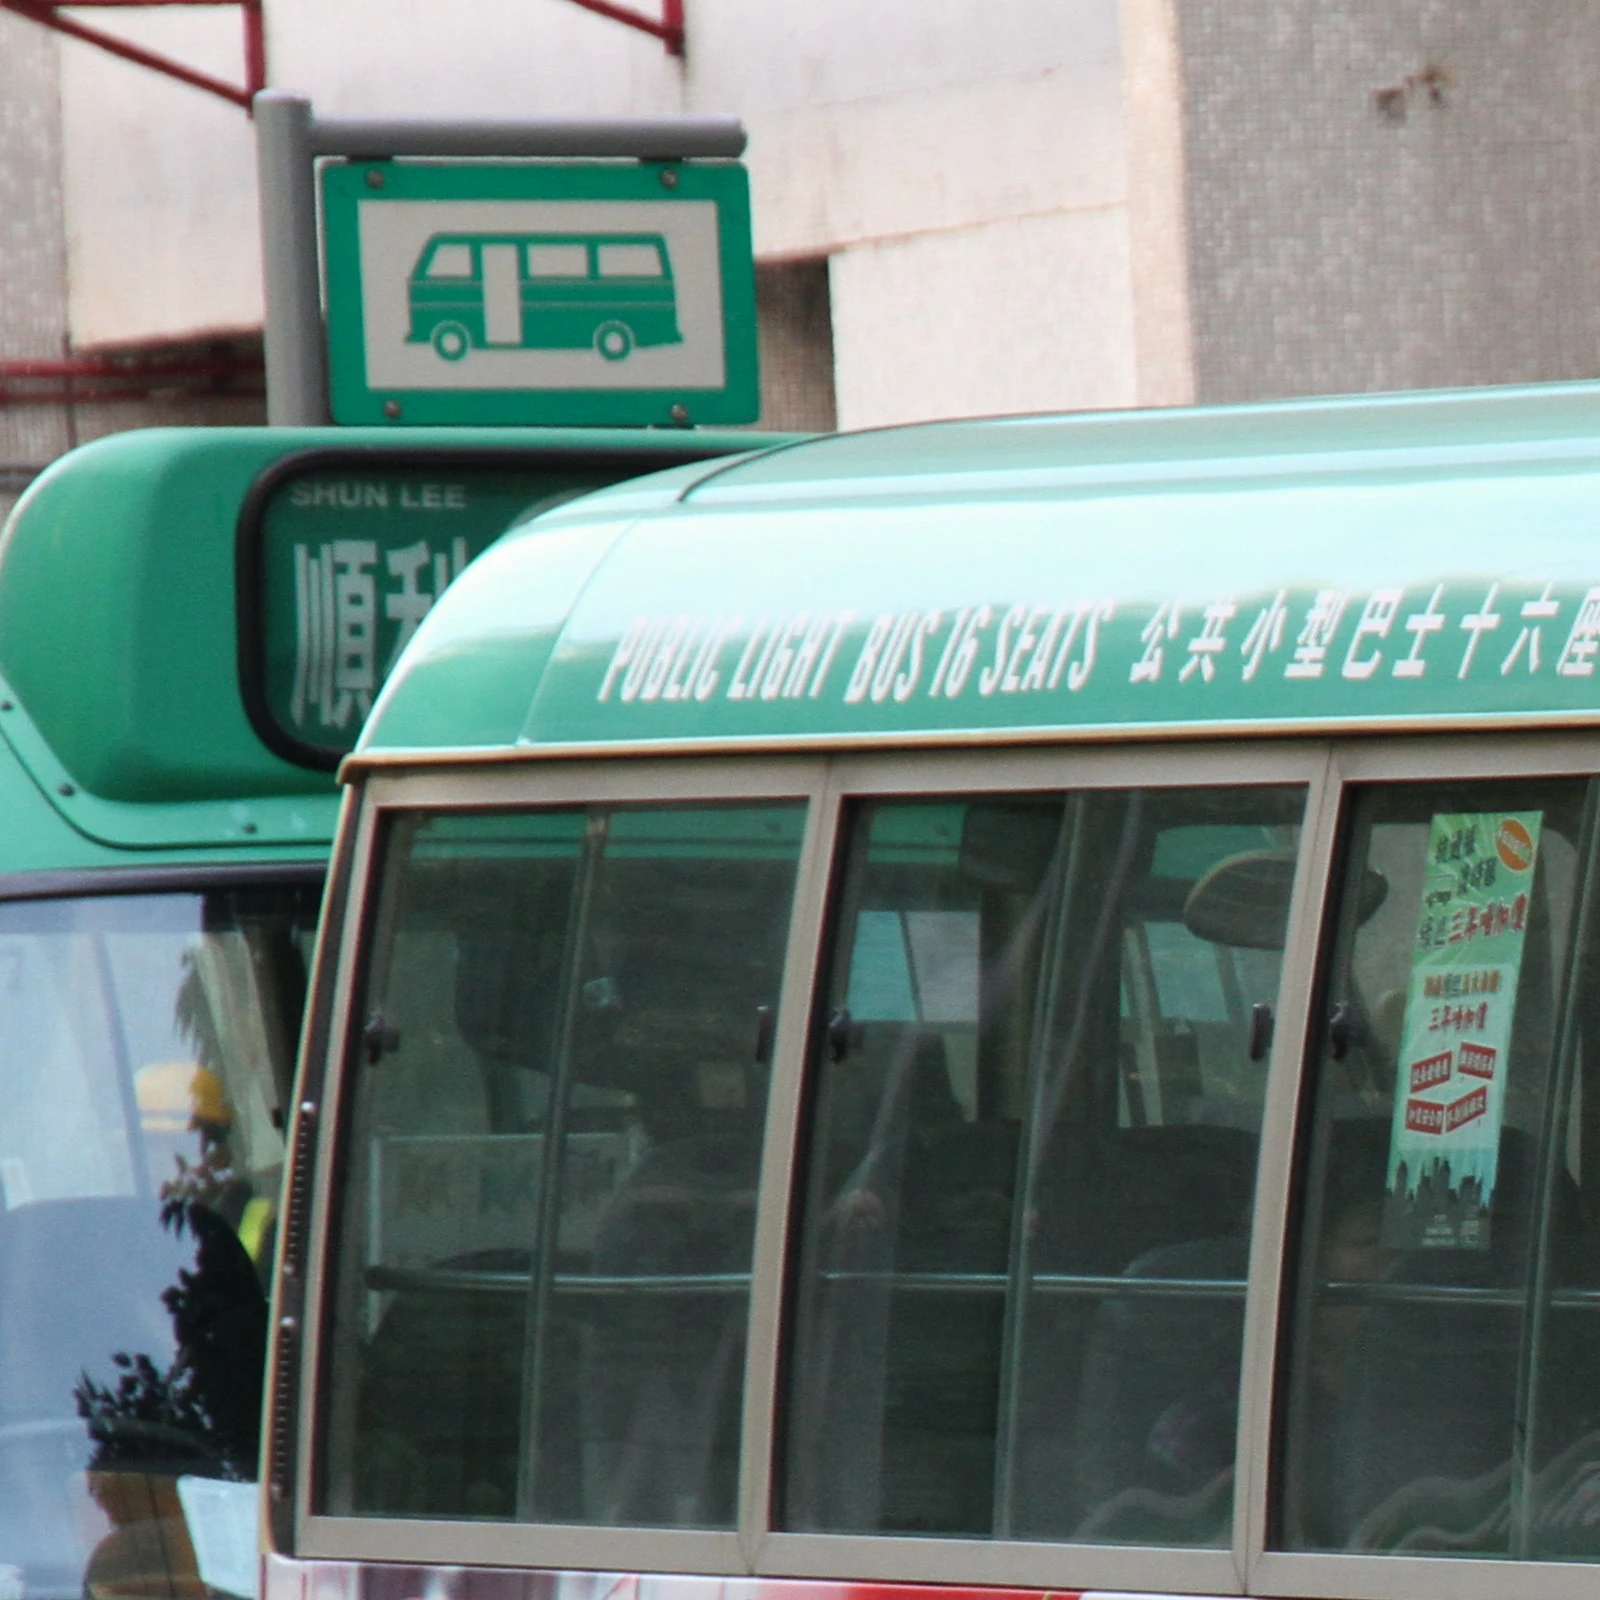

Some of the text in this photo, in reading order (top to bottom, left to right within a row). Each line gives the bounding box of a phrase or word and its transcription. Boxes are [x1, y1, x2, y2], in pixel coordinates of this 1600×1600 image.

[290, 482, 467, 510] SHUN LEE
[726, 608, 856, 702] LIGHT
[842, 610, 942, 704] BUS
[929, 604, 992, 699] 16
[979, 598, 1117, 696] SEATS
